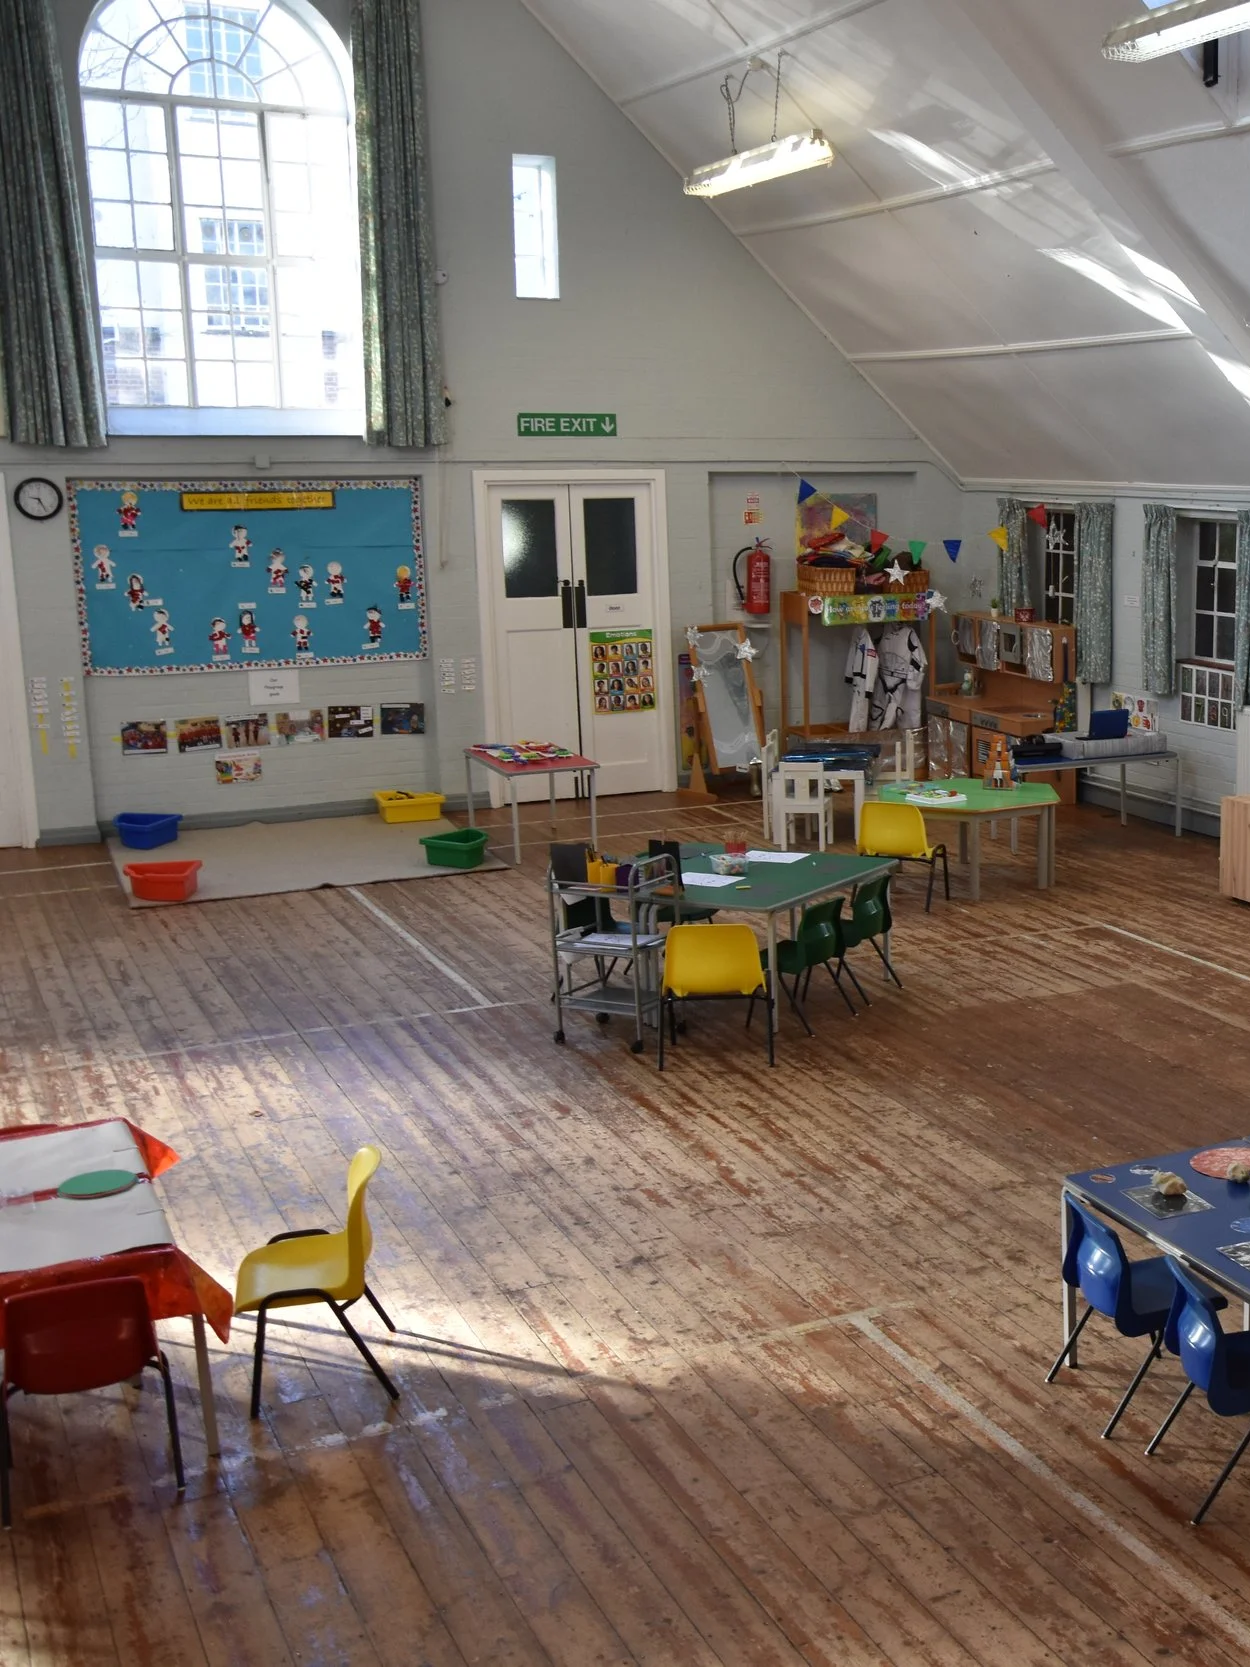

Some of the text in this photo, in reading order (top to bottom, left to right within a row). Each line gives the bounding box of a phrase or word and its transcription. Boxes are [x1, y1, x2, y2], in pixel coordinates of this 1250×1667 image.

[520, 417, 597, 432] FIRE EXIT
[188, 497, 205, 505] We
[245, 495, 282, 505] friends
[286, 494, 325, 506] together
[827, 605, 843, 613] How
[605, 631, 637, 639] Emotions
